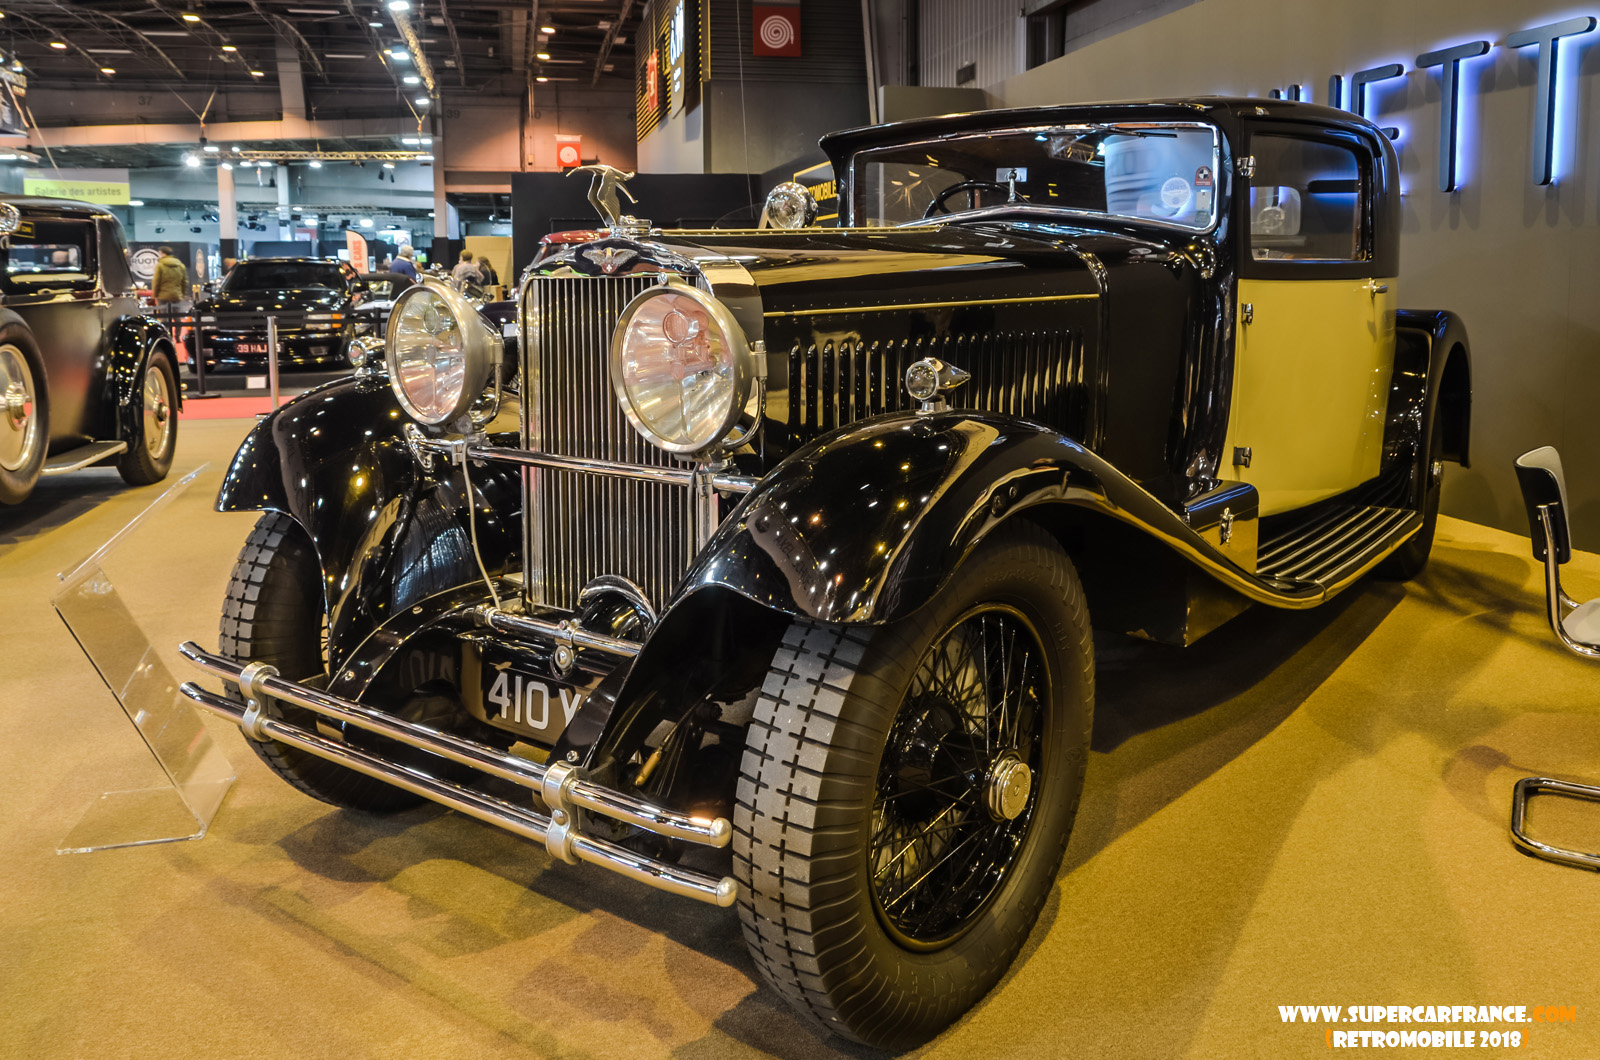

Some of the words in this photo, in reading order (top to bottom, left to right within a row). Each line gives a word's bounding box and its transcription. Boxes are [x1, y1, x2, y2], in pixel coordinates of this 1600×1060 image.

[137, 95, 152, 106] 37
[34, 186, 67, 196] Galerie
[68, 187, 84, 196] des
[87, 187, 121, 196] artistes
[353, 240, 363, 260] CARS
[250, 344, 268, 353] HAJ
[488, 671, 549, 730] 410
